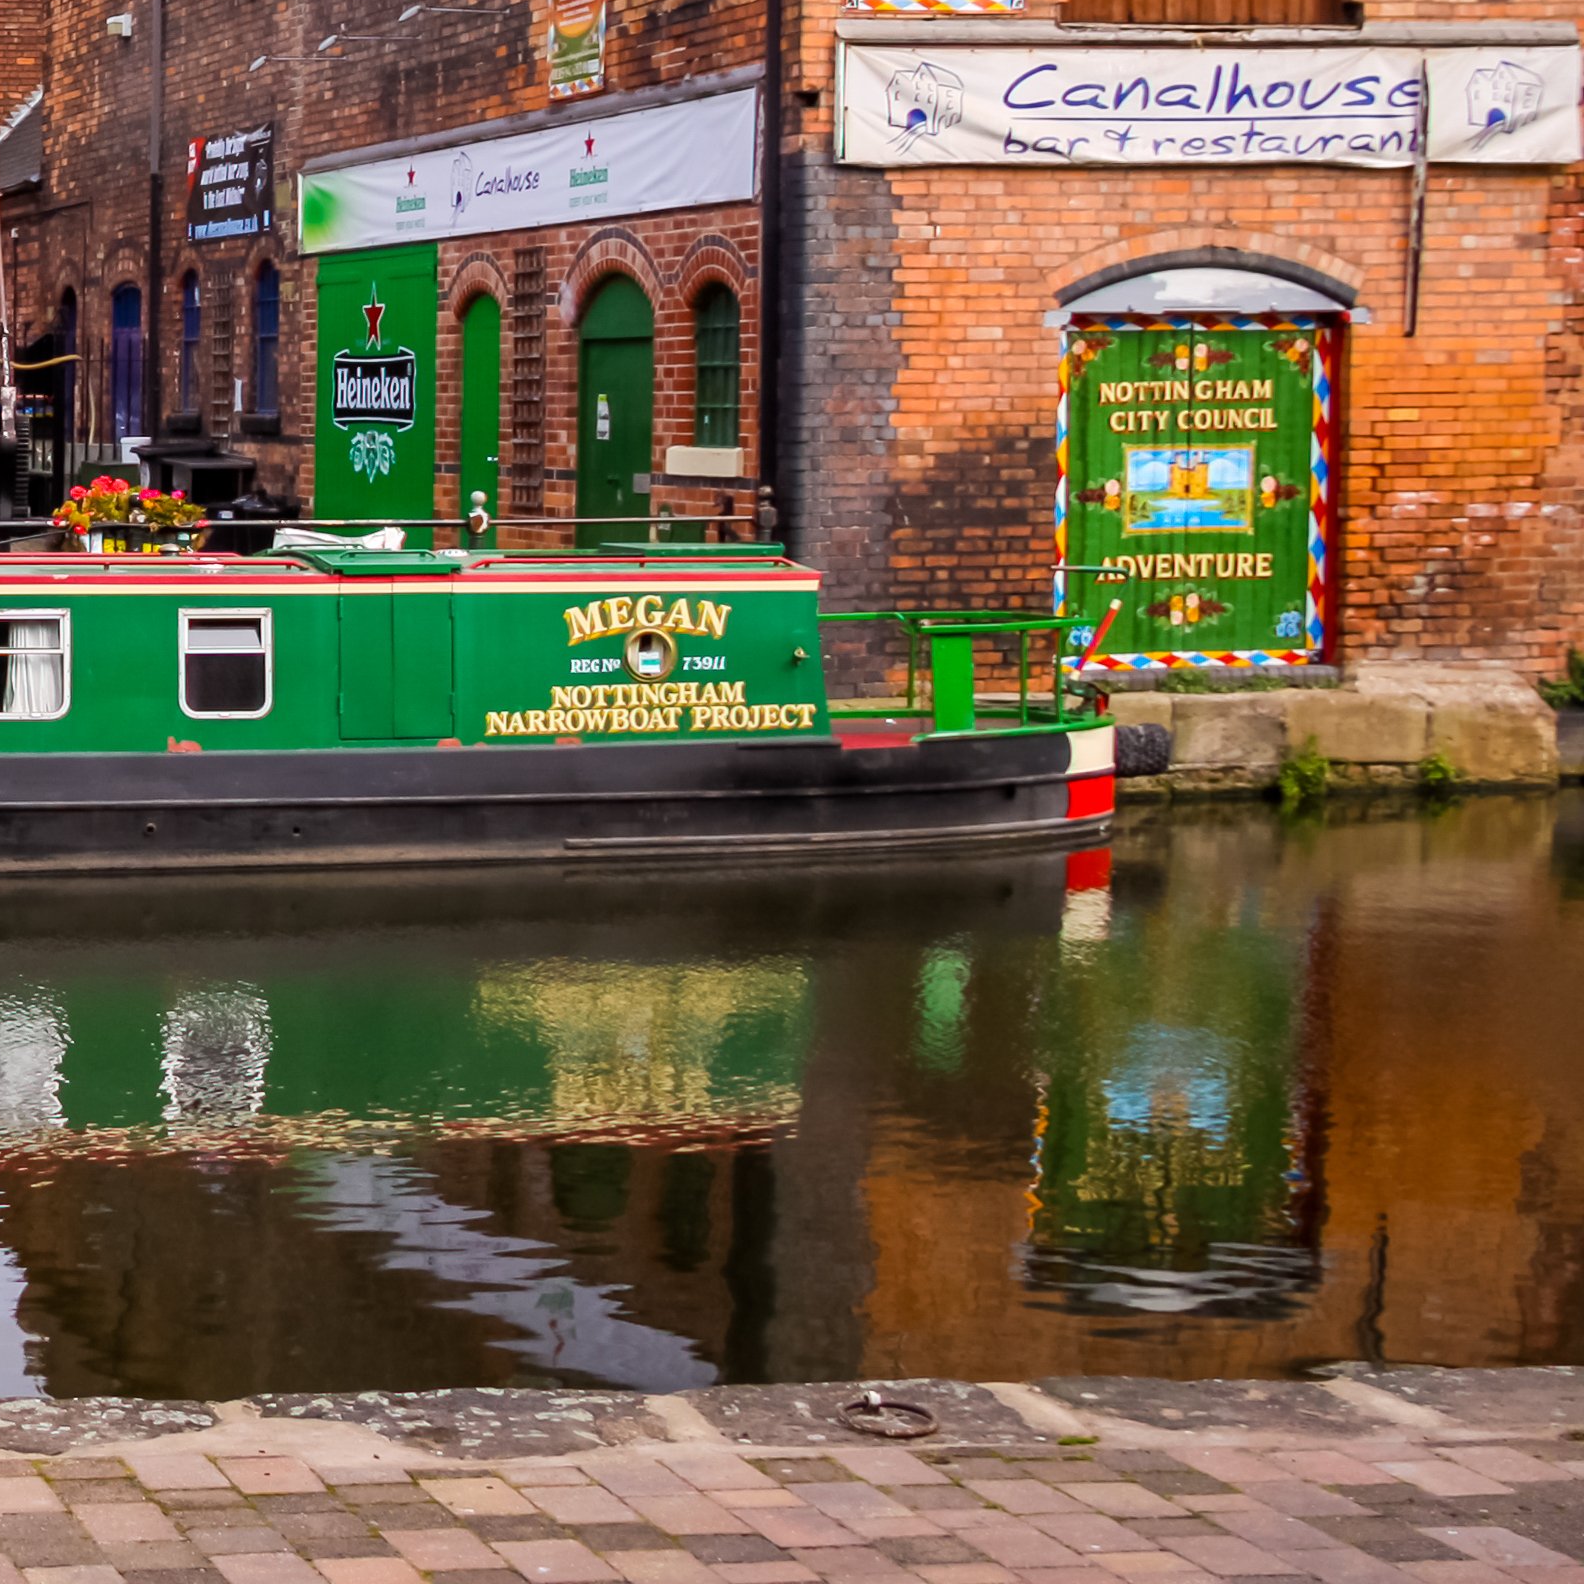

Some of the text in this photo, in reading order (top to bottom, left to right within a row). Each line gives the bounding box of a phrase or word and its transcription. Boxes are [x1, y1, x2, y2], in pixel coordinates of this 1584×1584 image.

[1003, 62, 1421, 114] Canalhouse
[1003, 127, 1090, 156] bar
[1152, 120, 1420, 158] restaurant
[476, 166, 540, 197] Canalhouse
[336, 366, 411, 409] Heineken
[1098, 379, 1274, 406] NOTTINGHAM
[1109, 408, 1279, 433] CITY COUNCIL
[1095, 553, 1274, 584] ADVENTURE
[564, 594, 732, 646] MEGAN
[570, 659, 600, 673] REG
[550, 681, 746, 710] NOTTINGHAM
[485, 704, 817, 737] NARROWBOAT PROJECT
